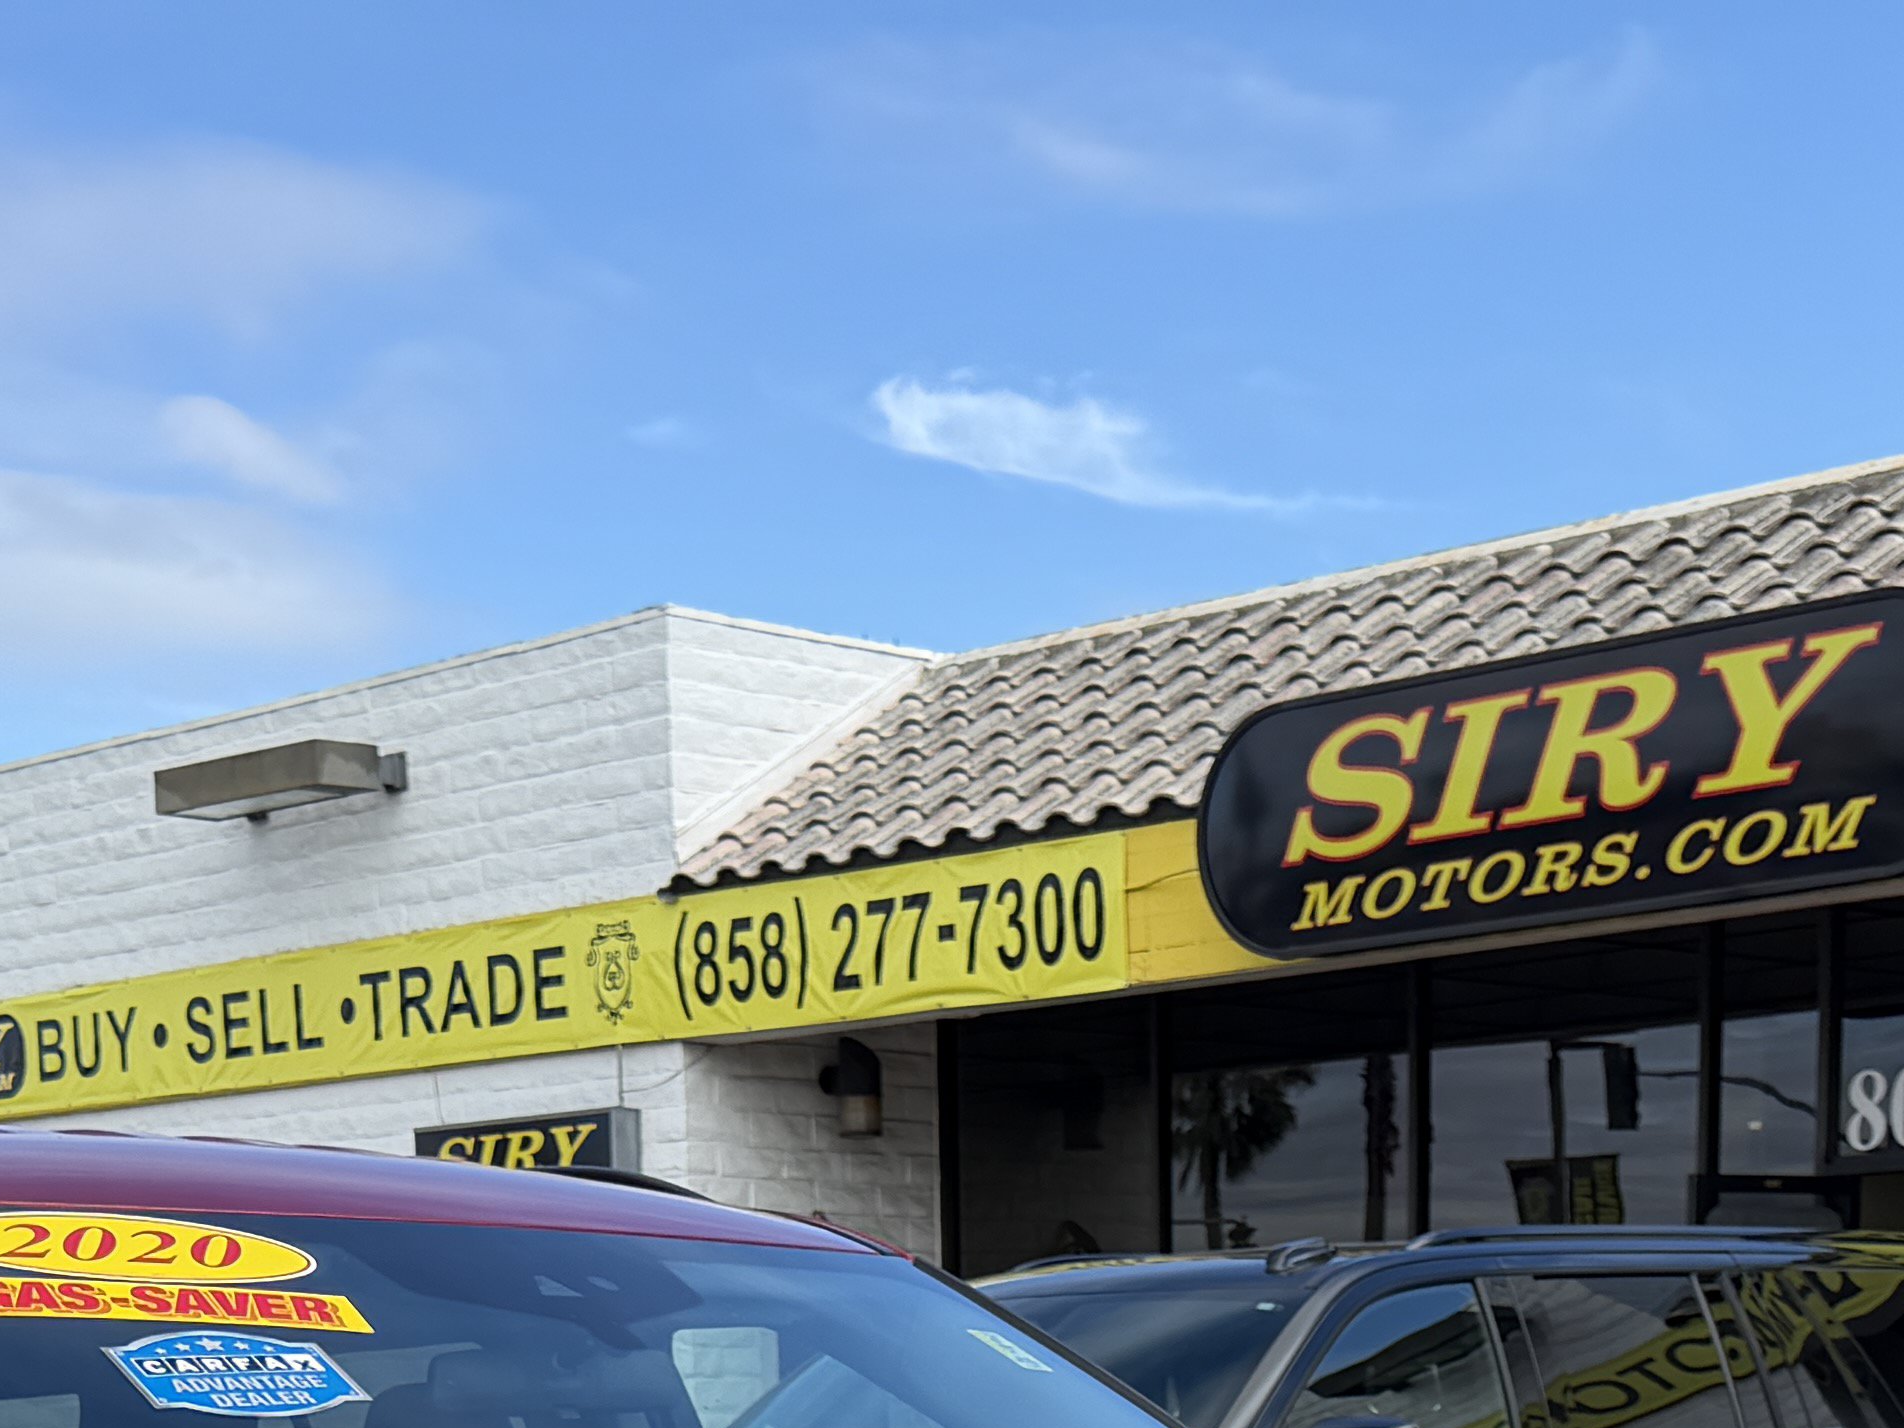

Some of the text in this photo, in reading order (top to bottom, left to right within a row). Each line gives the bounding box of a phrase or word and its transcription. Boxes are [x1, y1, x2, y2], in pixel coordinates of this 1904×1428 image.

[1282, 621, 1884, 867] SIRY
[1290, 795, 1876, 931] MOTORS.COM
[674, 866, 1104, 1019] (858) 277-7300
[39, 945, 569, 1081] BUY SELL TRADE
[142, 1355, 325, 1373] CARFAX
[171, 1374, 328, 1393] ADVANTAGE
[212, 1391, 317, 1408] DEALER
